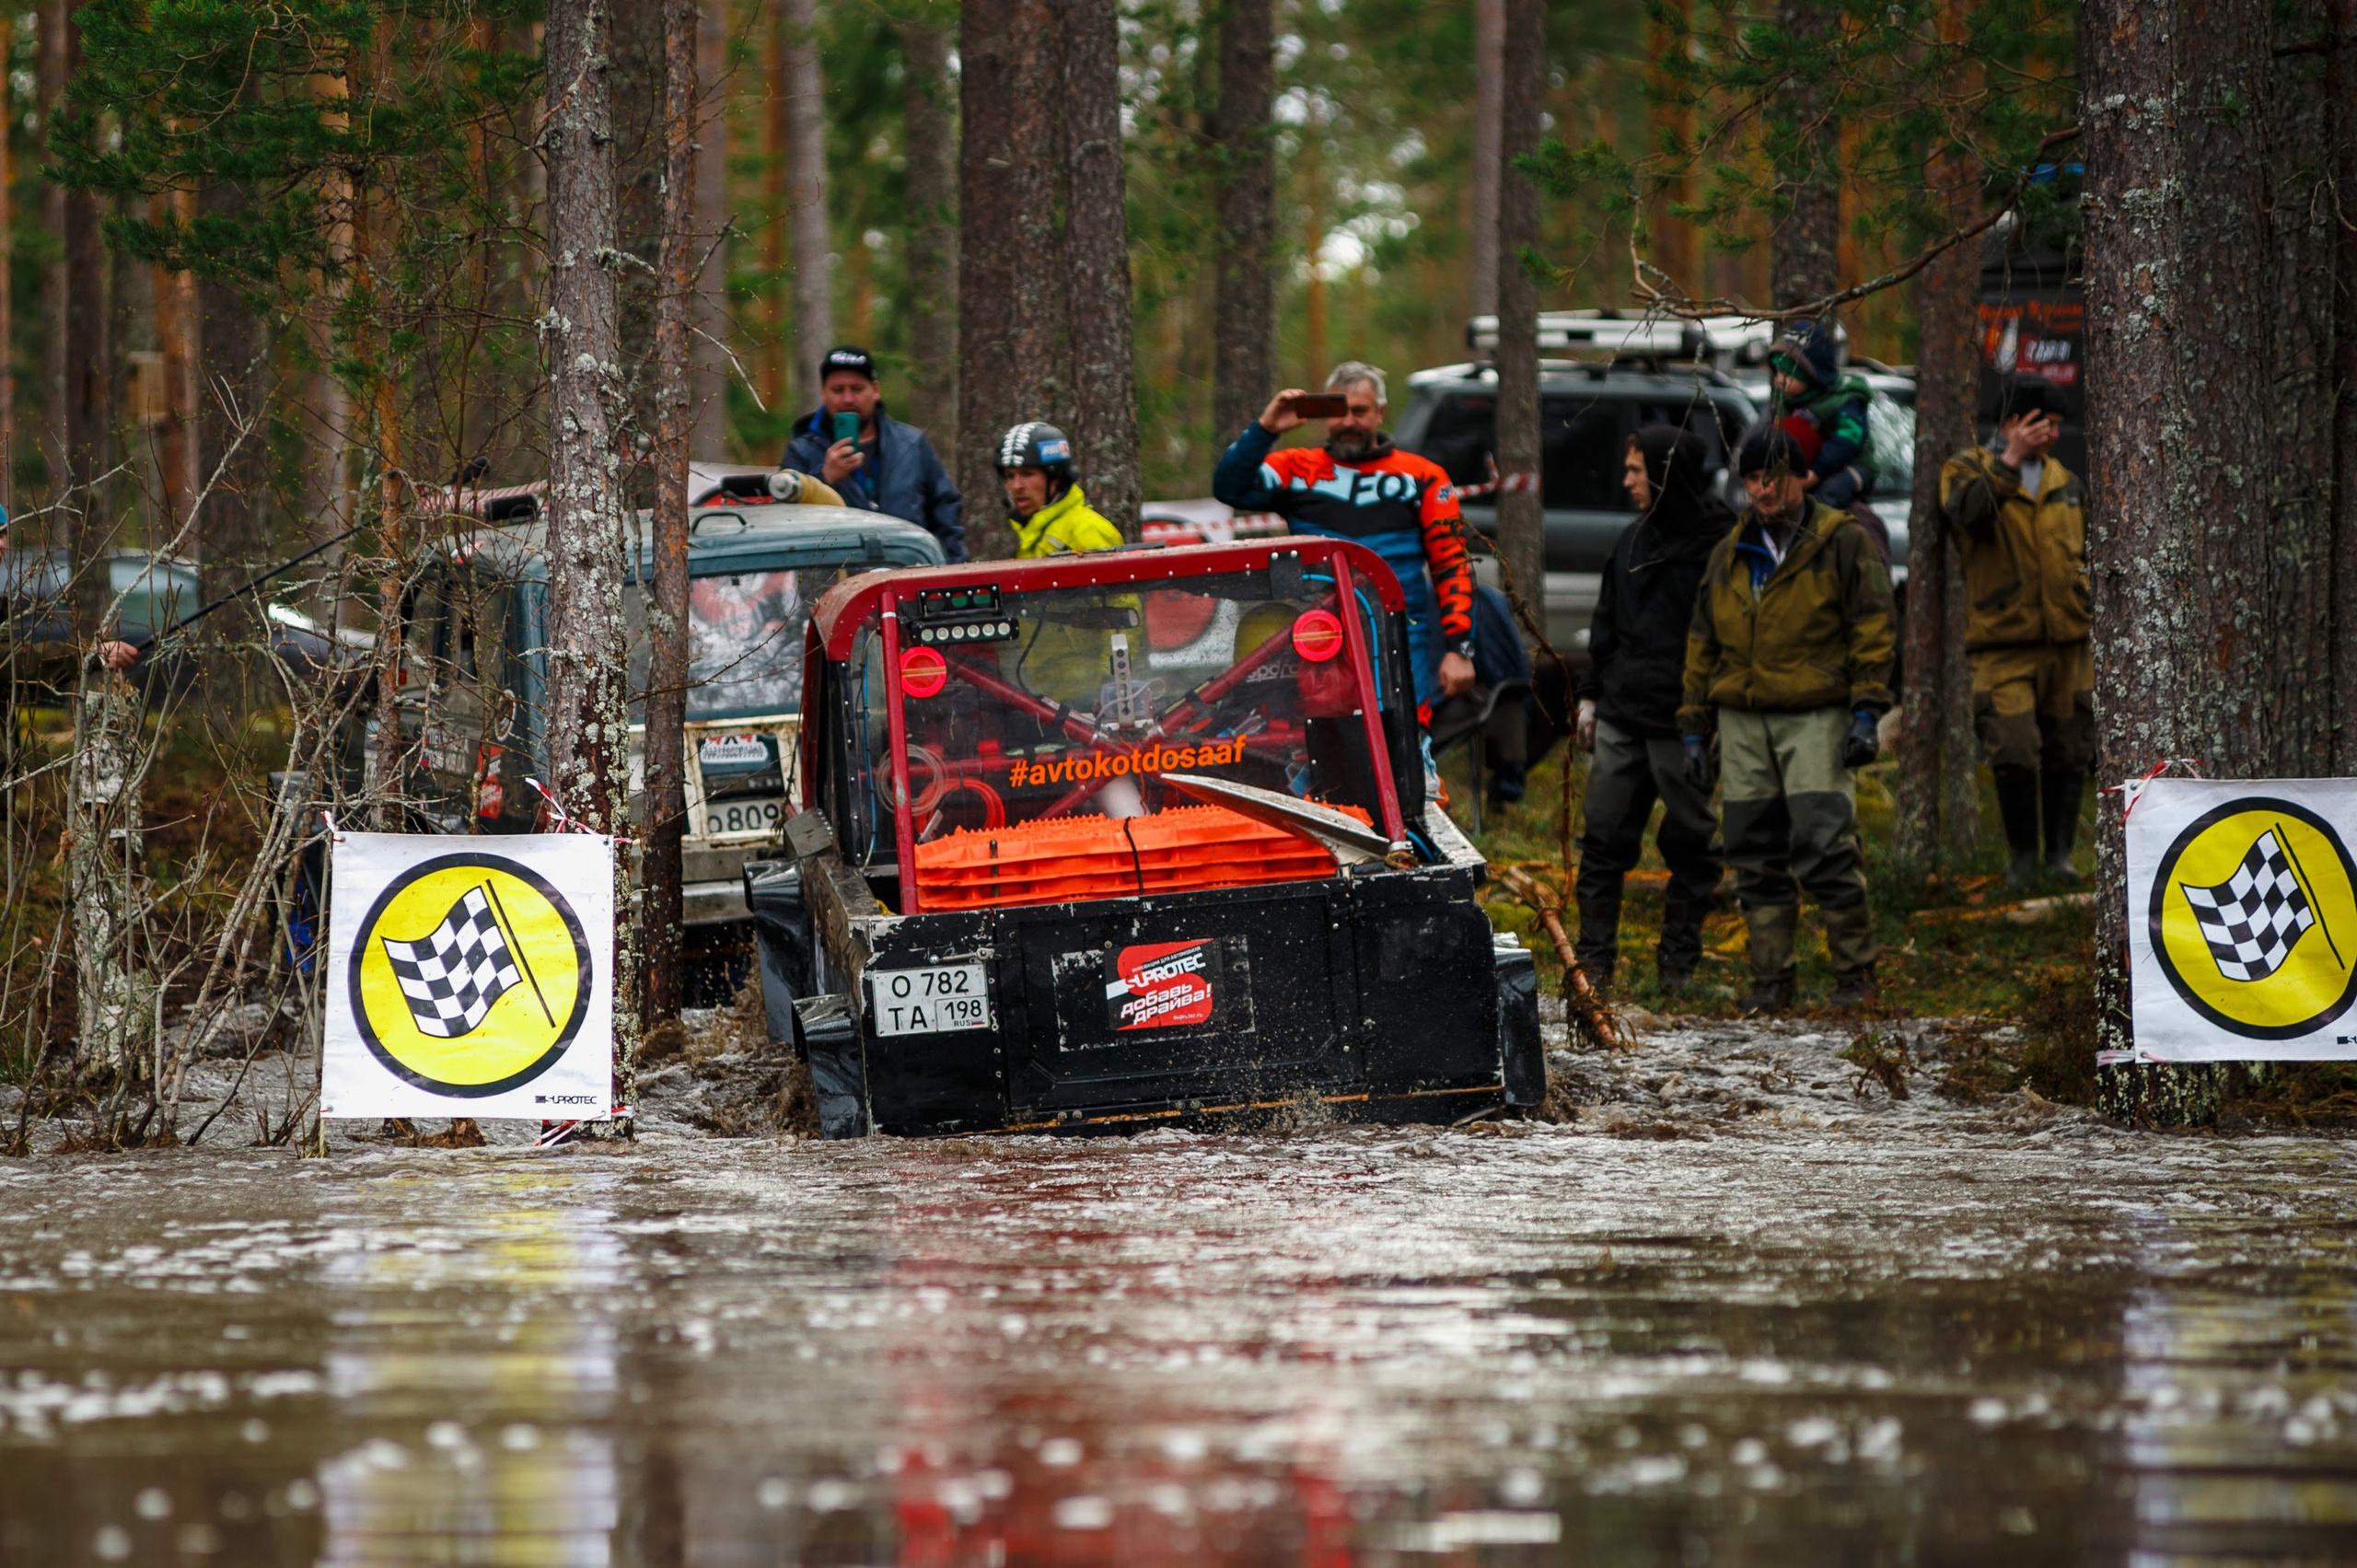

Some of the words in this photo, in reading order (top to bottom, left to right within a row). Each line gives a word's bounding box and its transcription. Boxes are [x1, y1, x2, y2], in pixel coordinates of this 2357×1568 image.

[1009, 734, 1247, 787] #avtokotdosaaf
[1124, 952, 1206, 989] SUPROTEC
[921, 970, 970, 996] 782
[945, 999, 982, 1020] 198
[954, 1019, 971, 1028] RUS
[540, 1095, 598, 1105] SUPROTEC
